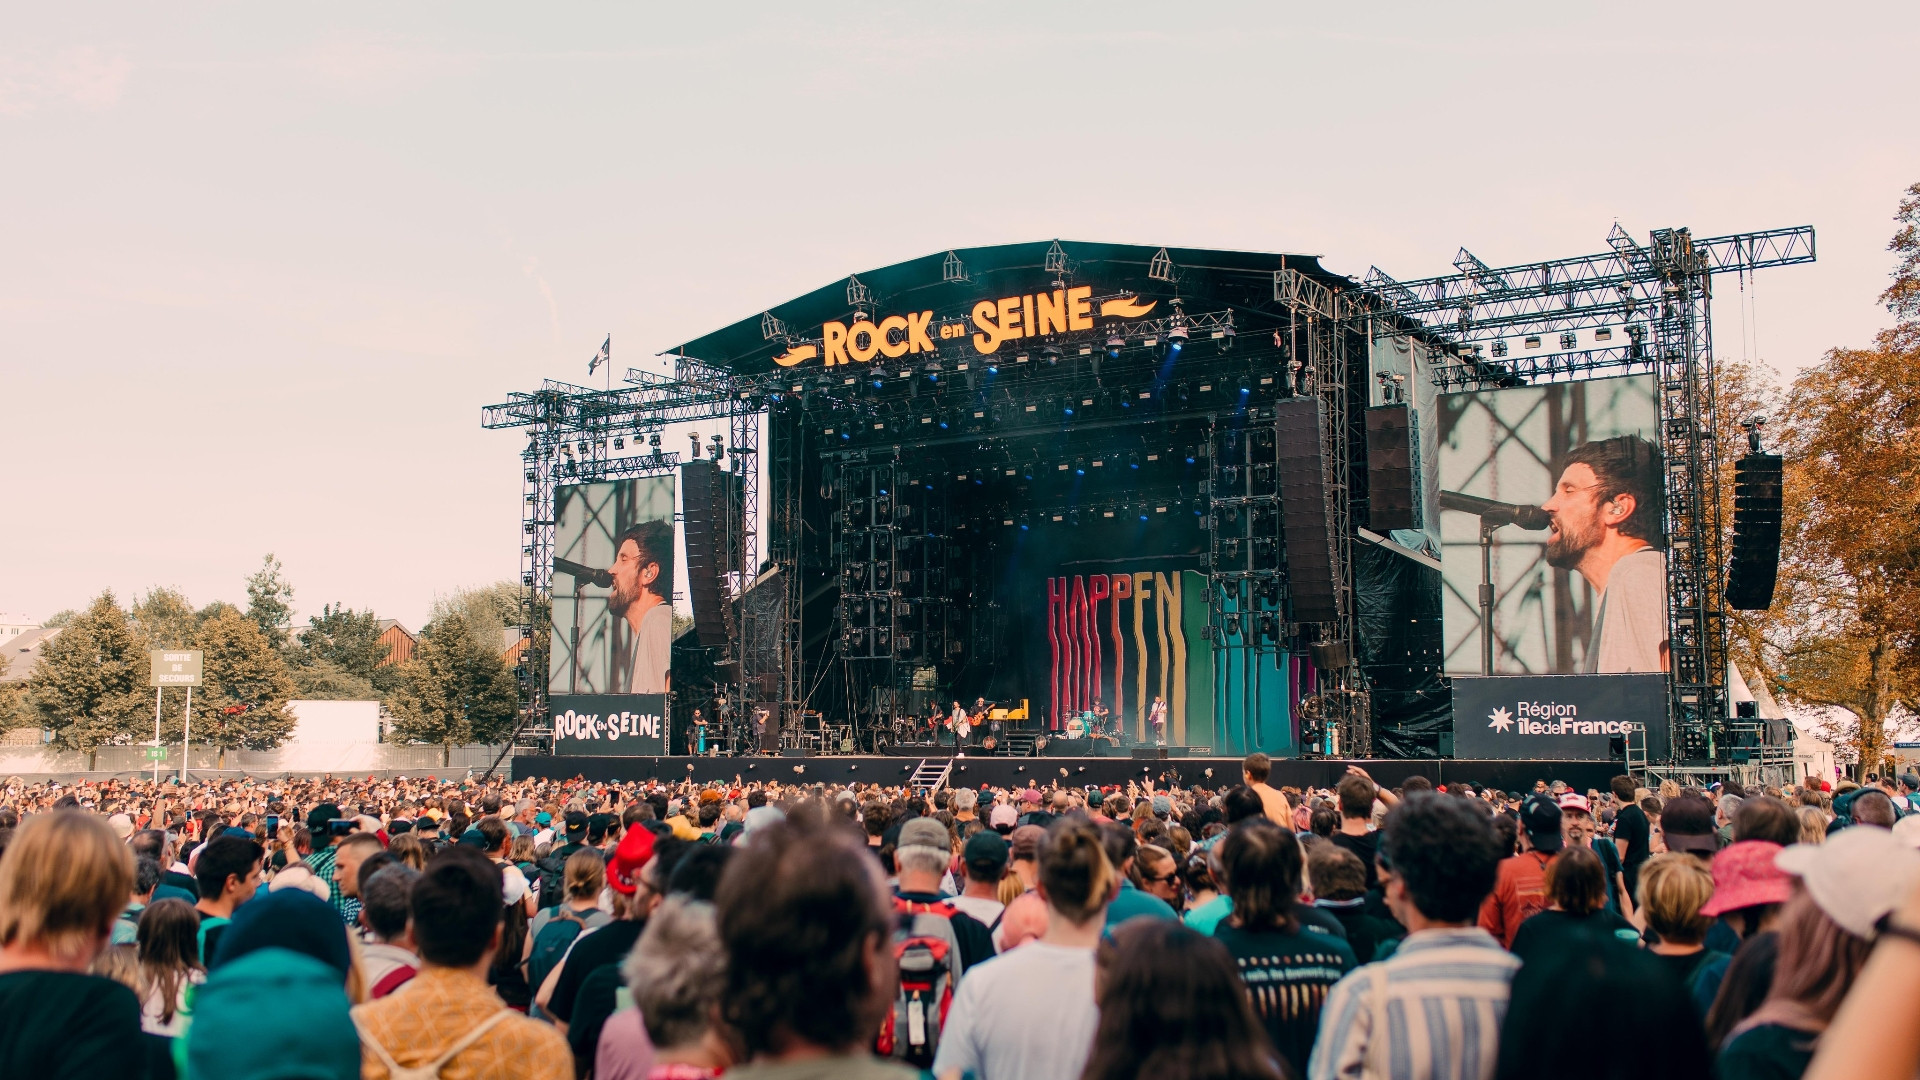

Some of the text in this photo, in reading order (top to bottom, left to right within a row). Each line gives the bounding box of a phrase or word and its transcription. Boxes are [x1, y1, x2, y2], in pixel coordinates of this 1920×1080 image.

[823, 285, 1094, 367] ROCK en SEINE
[163, 653, 191, 662] SORTIE
[172, 664, 183, 672] DE
[158, 674, 195, 683] SECOURS
[1517, 700, 1577, 720] Région
[555, 709, 661, 741] ROCK EN SEINE
